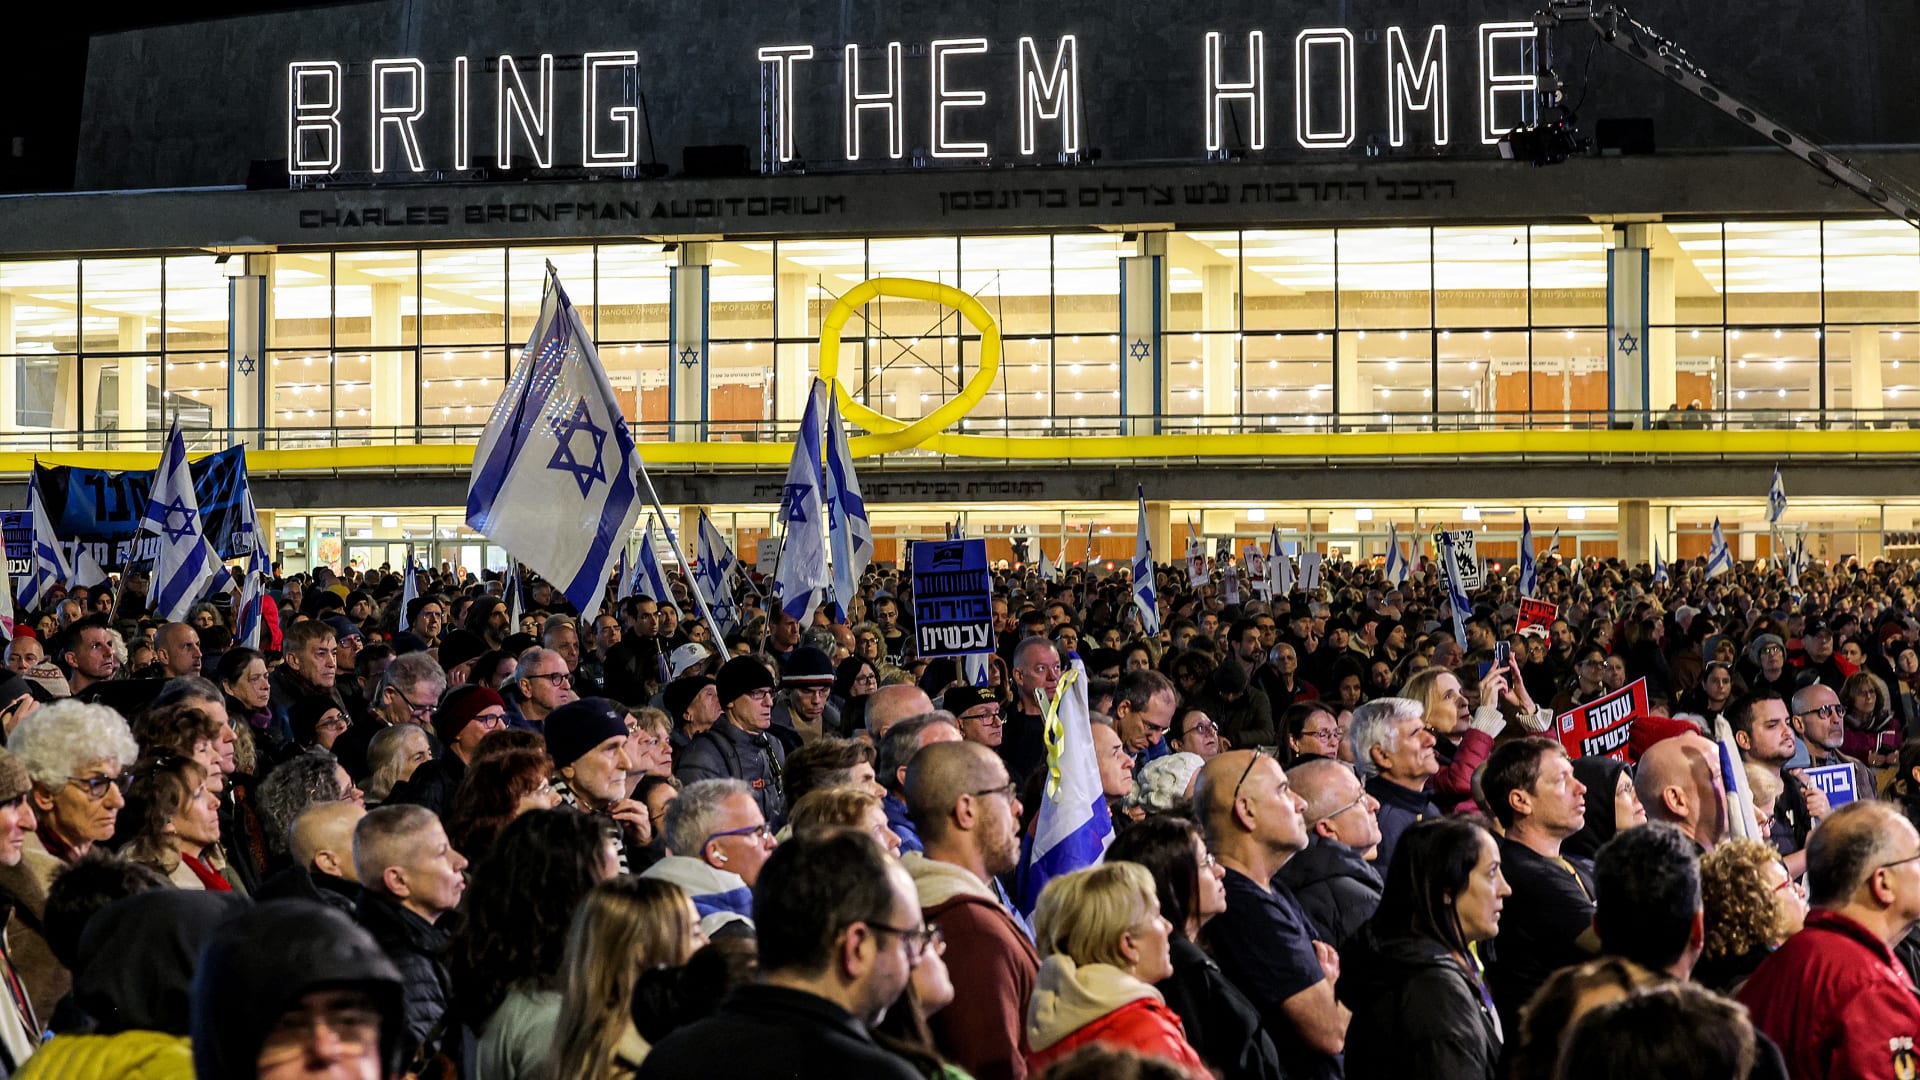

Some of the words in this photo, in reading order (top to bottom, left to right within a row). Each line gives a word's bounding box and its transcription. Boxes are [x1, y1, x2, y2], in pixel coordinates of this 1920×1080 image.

[288, 50, 639, 175] BRING
[758, 34, 1078, 162] THEM
[1205, 22, 1538, 150] HOME
[1240, 182, 1368, 203] התרבות
[1376, 176, 1456, 201] היכל
[300, 206, 449, 228] CHARLES
[464, 201, 640, 224] BRONFMAN
[650, 196, 846, 218] AUDITORIUM
[939, 189, 1067, 216] ברונפמן
[863, 480, 960, 496] הפילהרמונ
[966, 481, 1044, 496] התזמורת
[917, 598, 991, 620] בחירות
[922, 623, 990, 651] עכשיו!
[1589, 693, 1632, 732] עסקה
